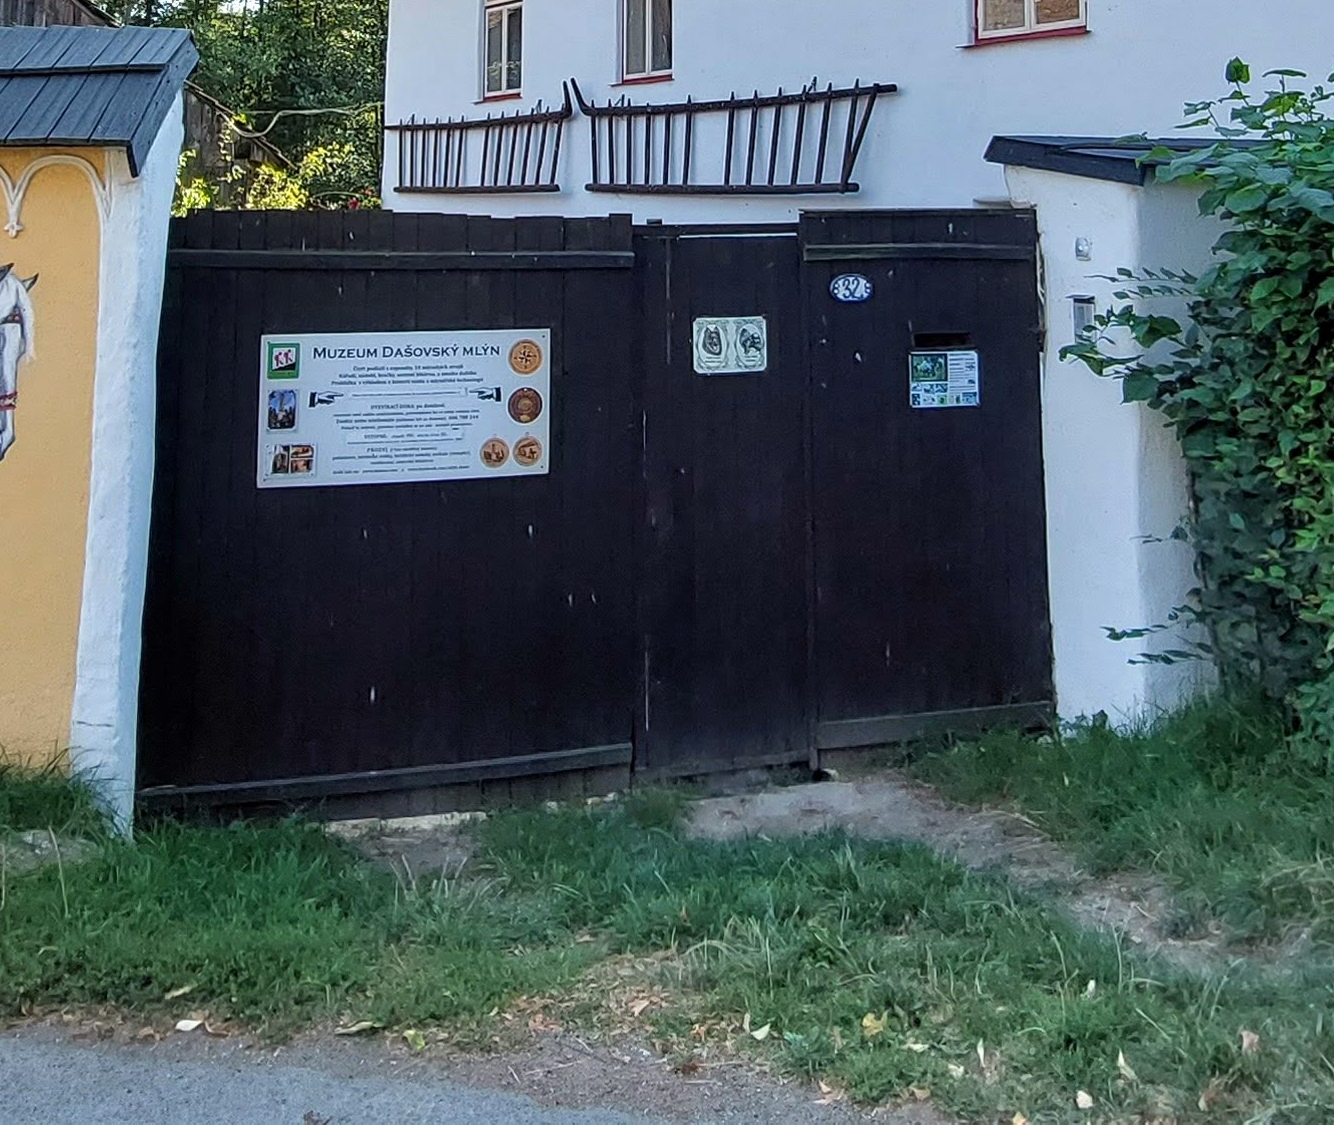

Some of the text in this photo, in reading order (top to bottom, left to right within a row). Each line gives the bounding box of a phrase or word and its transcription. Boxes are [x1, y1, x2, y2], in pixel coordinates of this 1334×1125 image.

[842, 277, 864, 299] 32
[313, 343, 500, 360] MUZEUM DAŠOVSKÝ MLÝN
